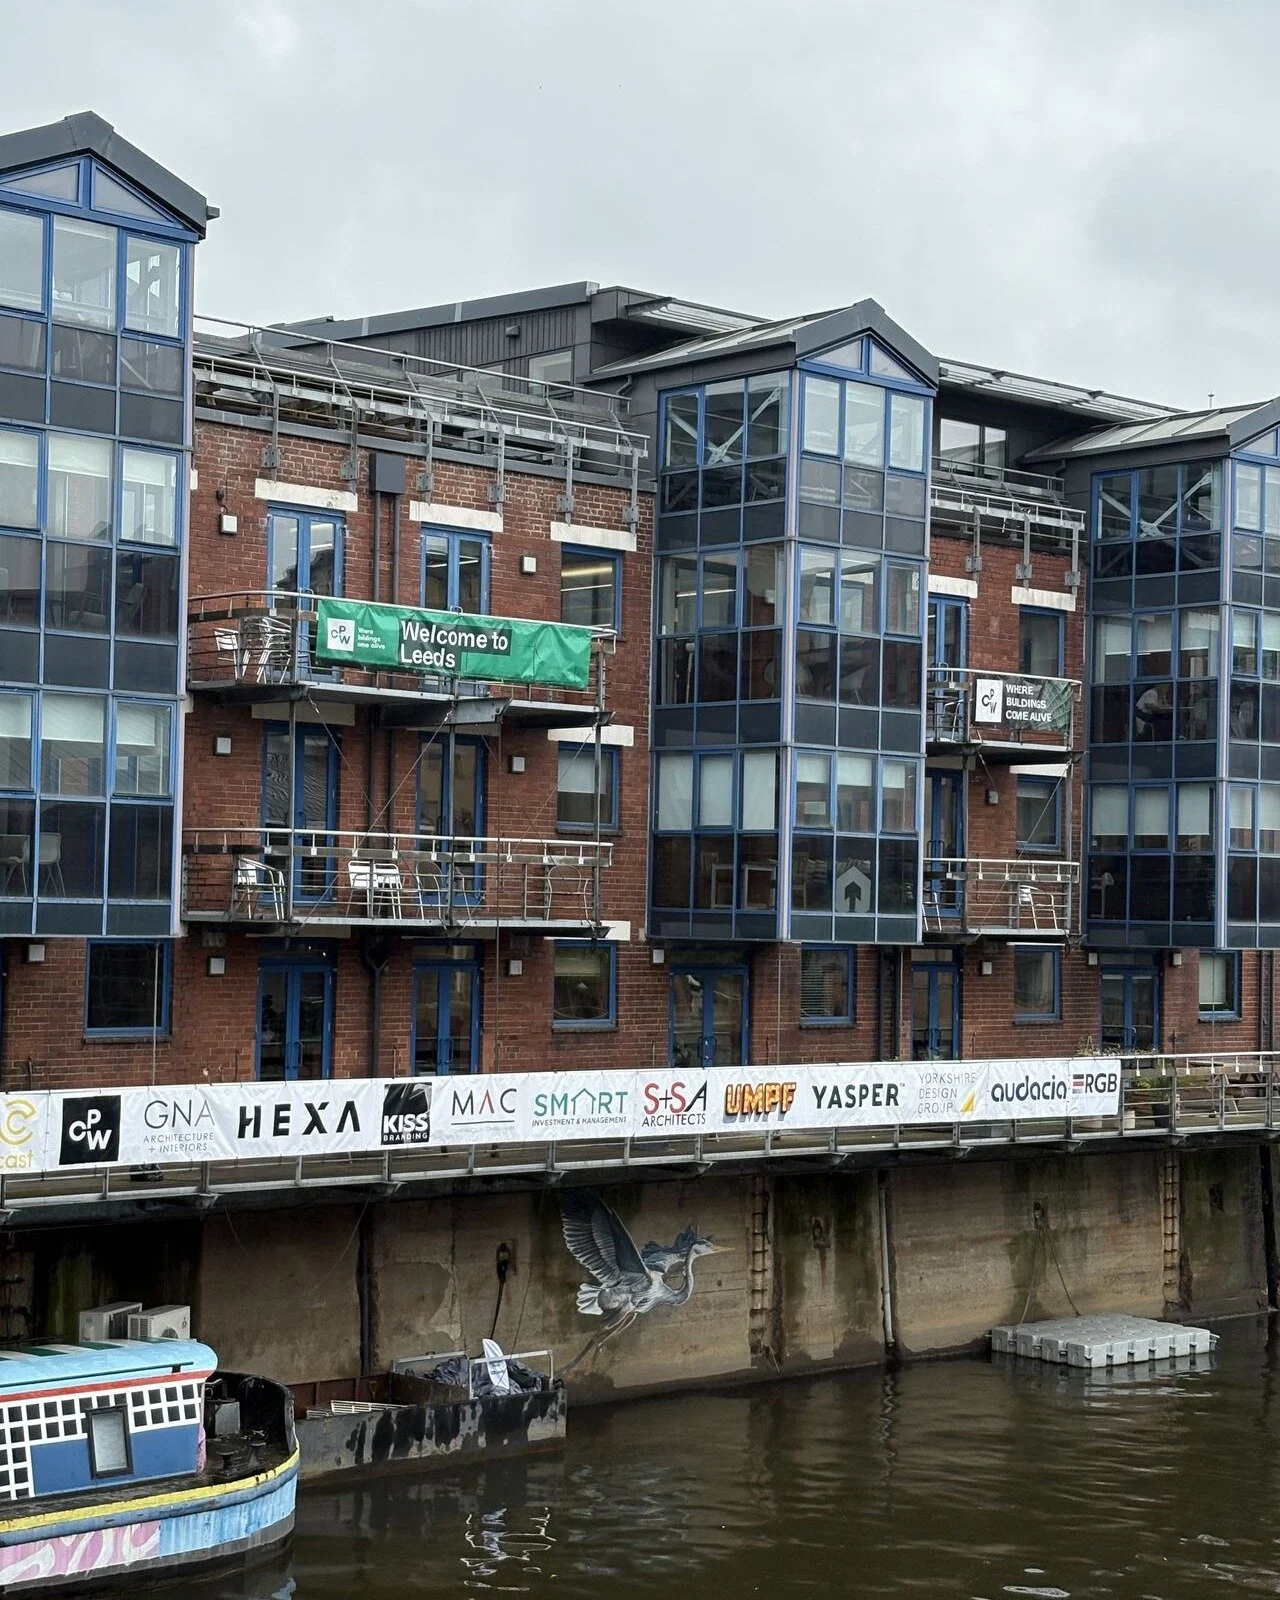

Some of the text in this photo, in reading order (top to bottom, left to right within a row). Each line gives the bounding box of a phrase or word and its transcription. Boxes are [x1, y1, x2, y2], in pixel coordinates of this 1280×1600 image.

[401, 620, 508, 650] Welcome to
[400, 643, 456, 668] Leeds
[1006, 684, 1034, 695] WHERE
[1005, 710, 1029, 720] COME
[918, 1072, 976, 1084] YORKSHIRE
[1085, 1073, 1118, 1094] RGB
[919, 1087, 957, 1099] DESIGN
[991, 1075, 1067, 1102] audacia
[452, 1088, 517, 1116] MAC
[724, 1082, 797, 1118] UMPF
[144, 1099, 215, 1129] GNA
[918, 1102, 953, 1114] GROUP
[238, 1100, 361, 1139] HEXA
[383, 1113, 428, 1133] KISS
[532, 1118, 575, 1127] INVESTMENT
[582, 1116, 627, 1124] MANAGEMENT
[642, 1113, 706, 1128] ARCHITECTS
[143, 1132, 214, 1143] ARCHITECTURE
[383, 1132, 428, 1142] BRANDING
[160, 1143, 207, 1154] INTERIORS
